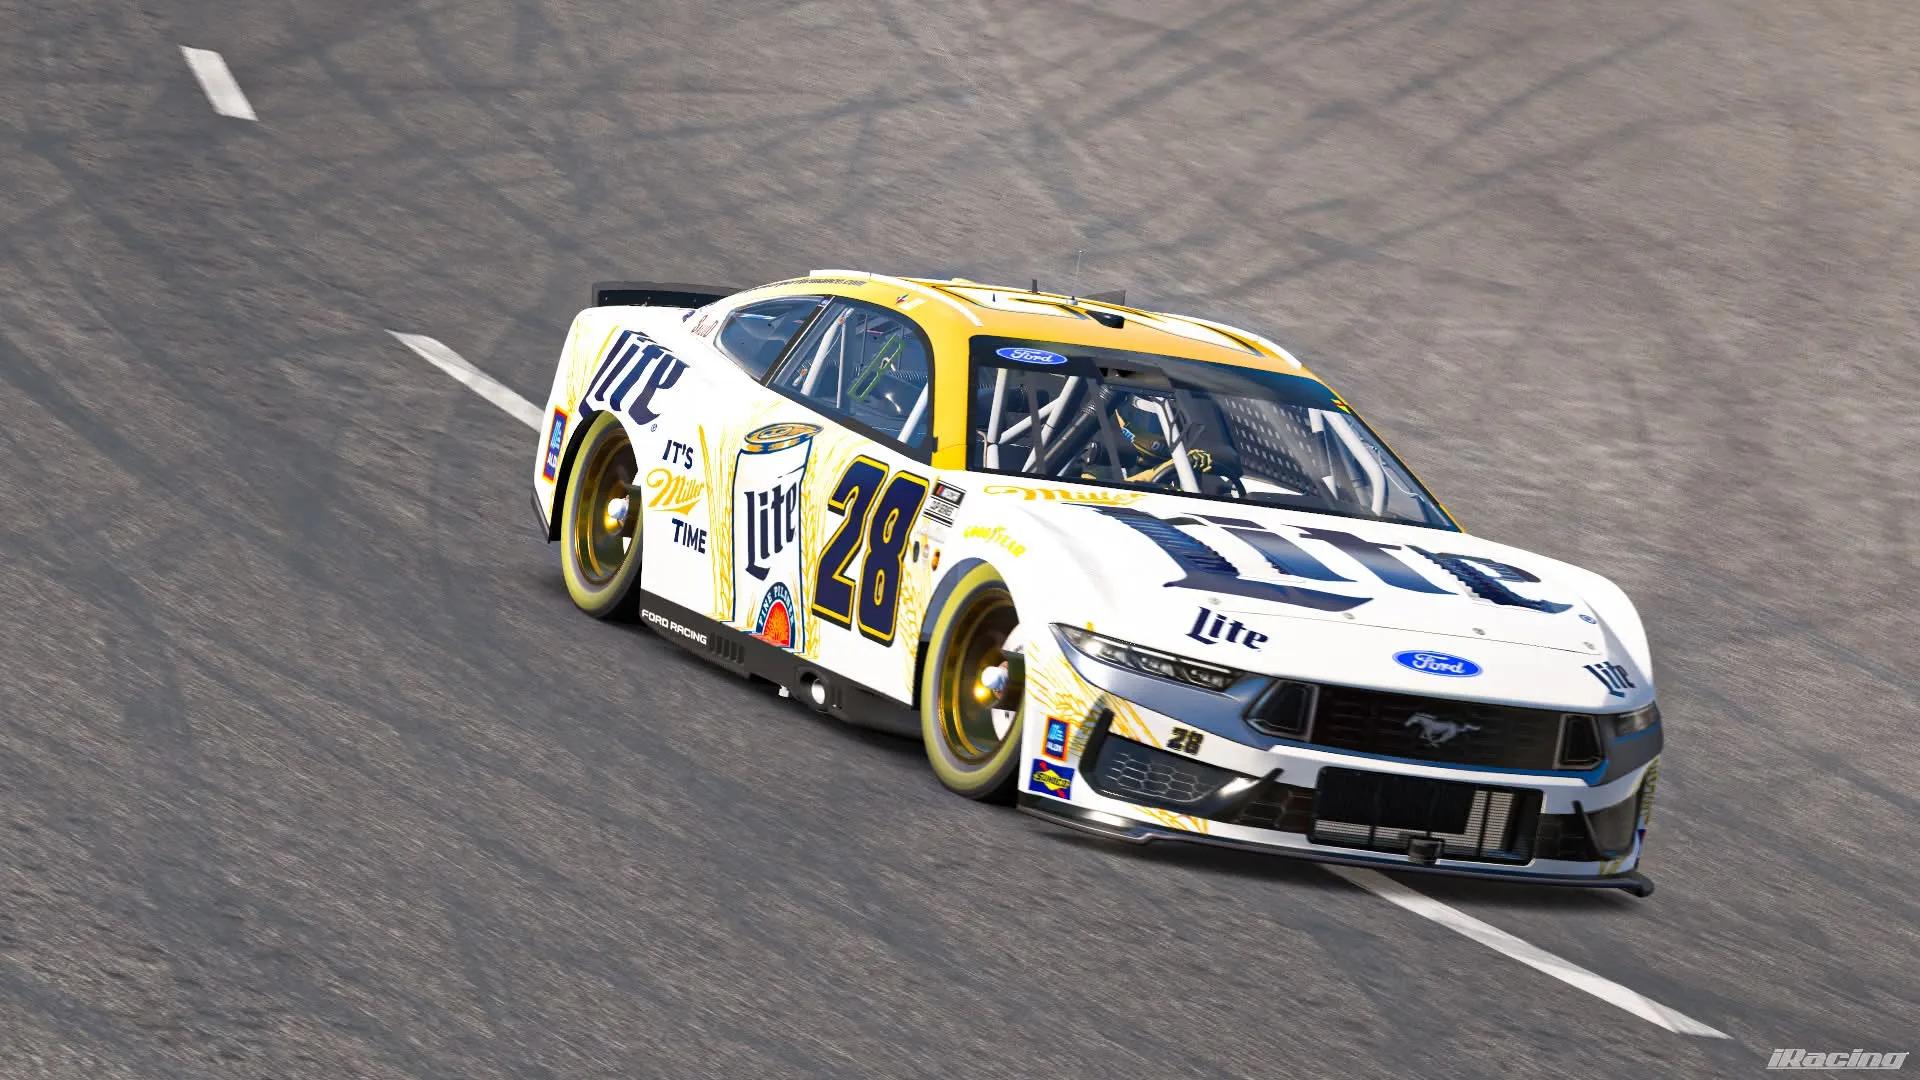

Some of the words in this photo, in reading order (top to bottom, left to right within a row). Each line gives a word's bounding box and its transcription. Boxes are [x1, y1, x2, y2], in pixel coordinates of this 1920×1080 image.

[1010, 348, 1053, 363] Ford
[579, 330, 690, 426] Lite
[661, 439, 694, 470] IT'S
[646, 467, 704, 513] Miller
[671, 517, 708, 554] TIME
[743, 481, 798, 581] Lite
[811, 454, 930, 648] 28
[1061, 502, 1573, 613] Lite
[641, 609, 669, 629] FORD
[670, 620, 707, 645] RACING
[1186, 606, 1270, 651] Lite
[1412, 653, 1466, 674] Ford
[1583, 661, 1636, 698] Lite
[1166, 727, 1205, 755] 28
